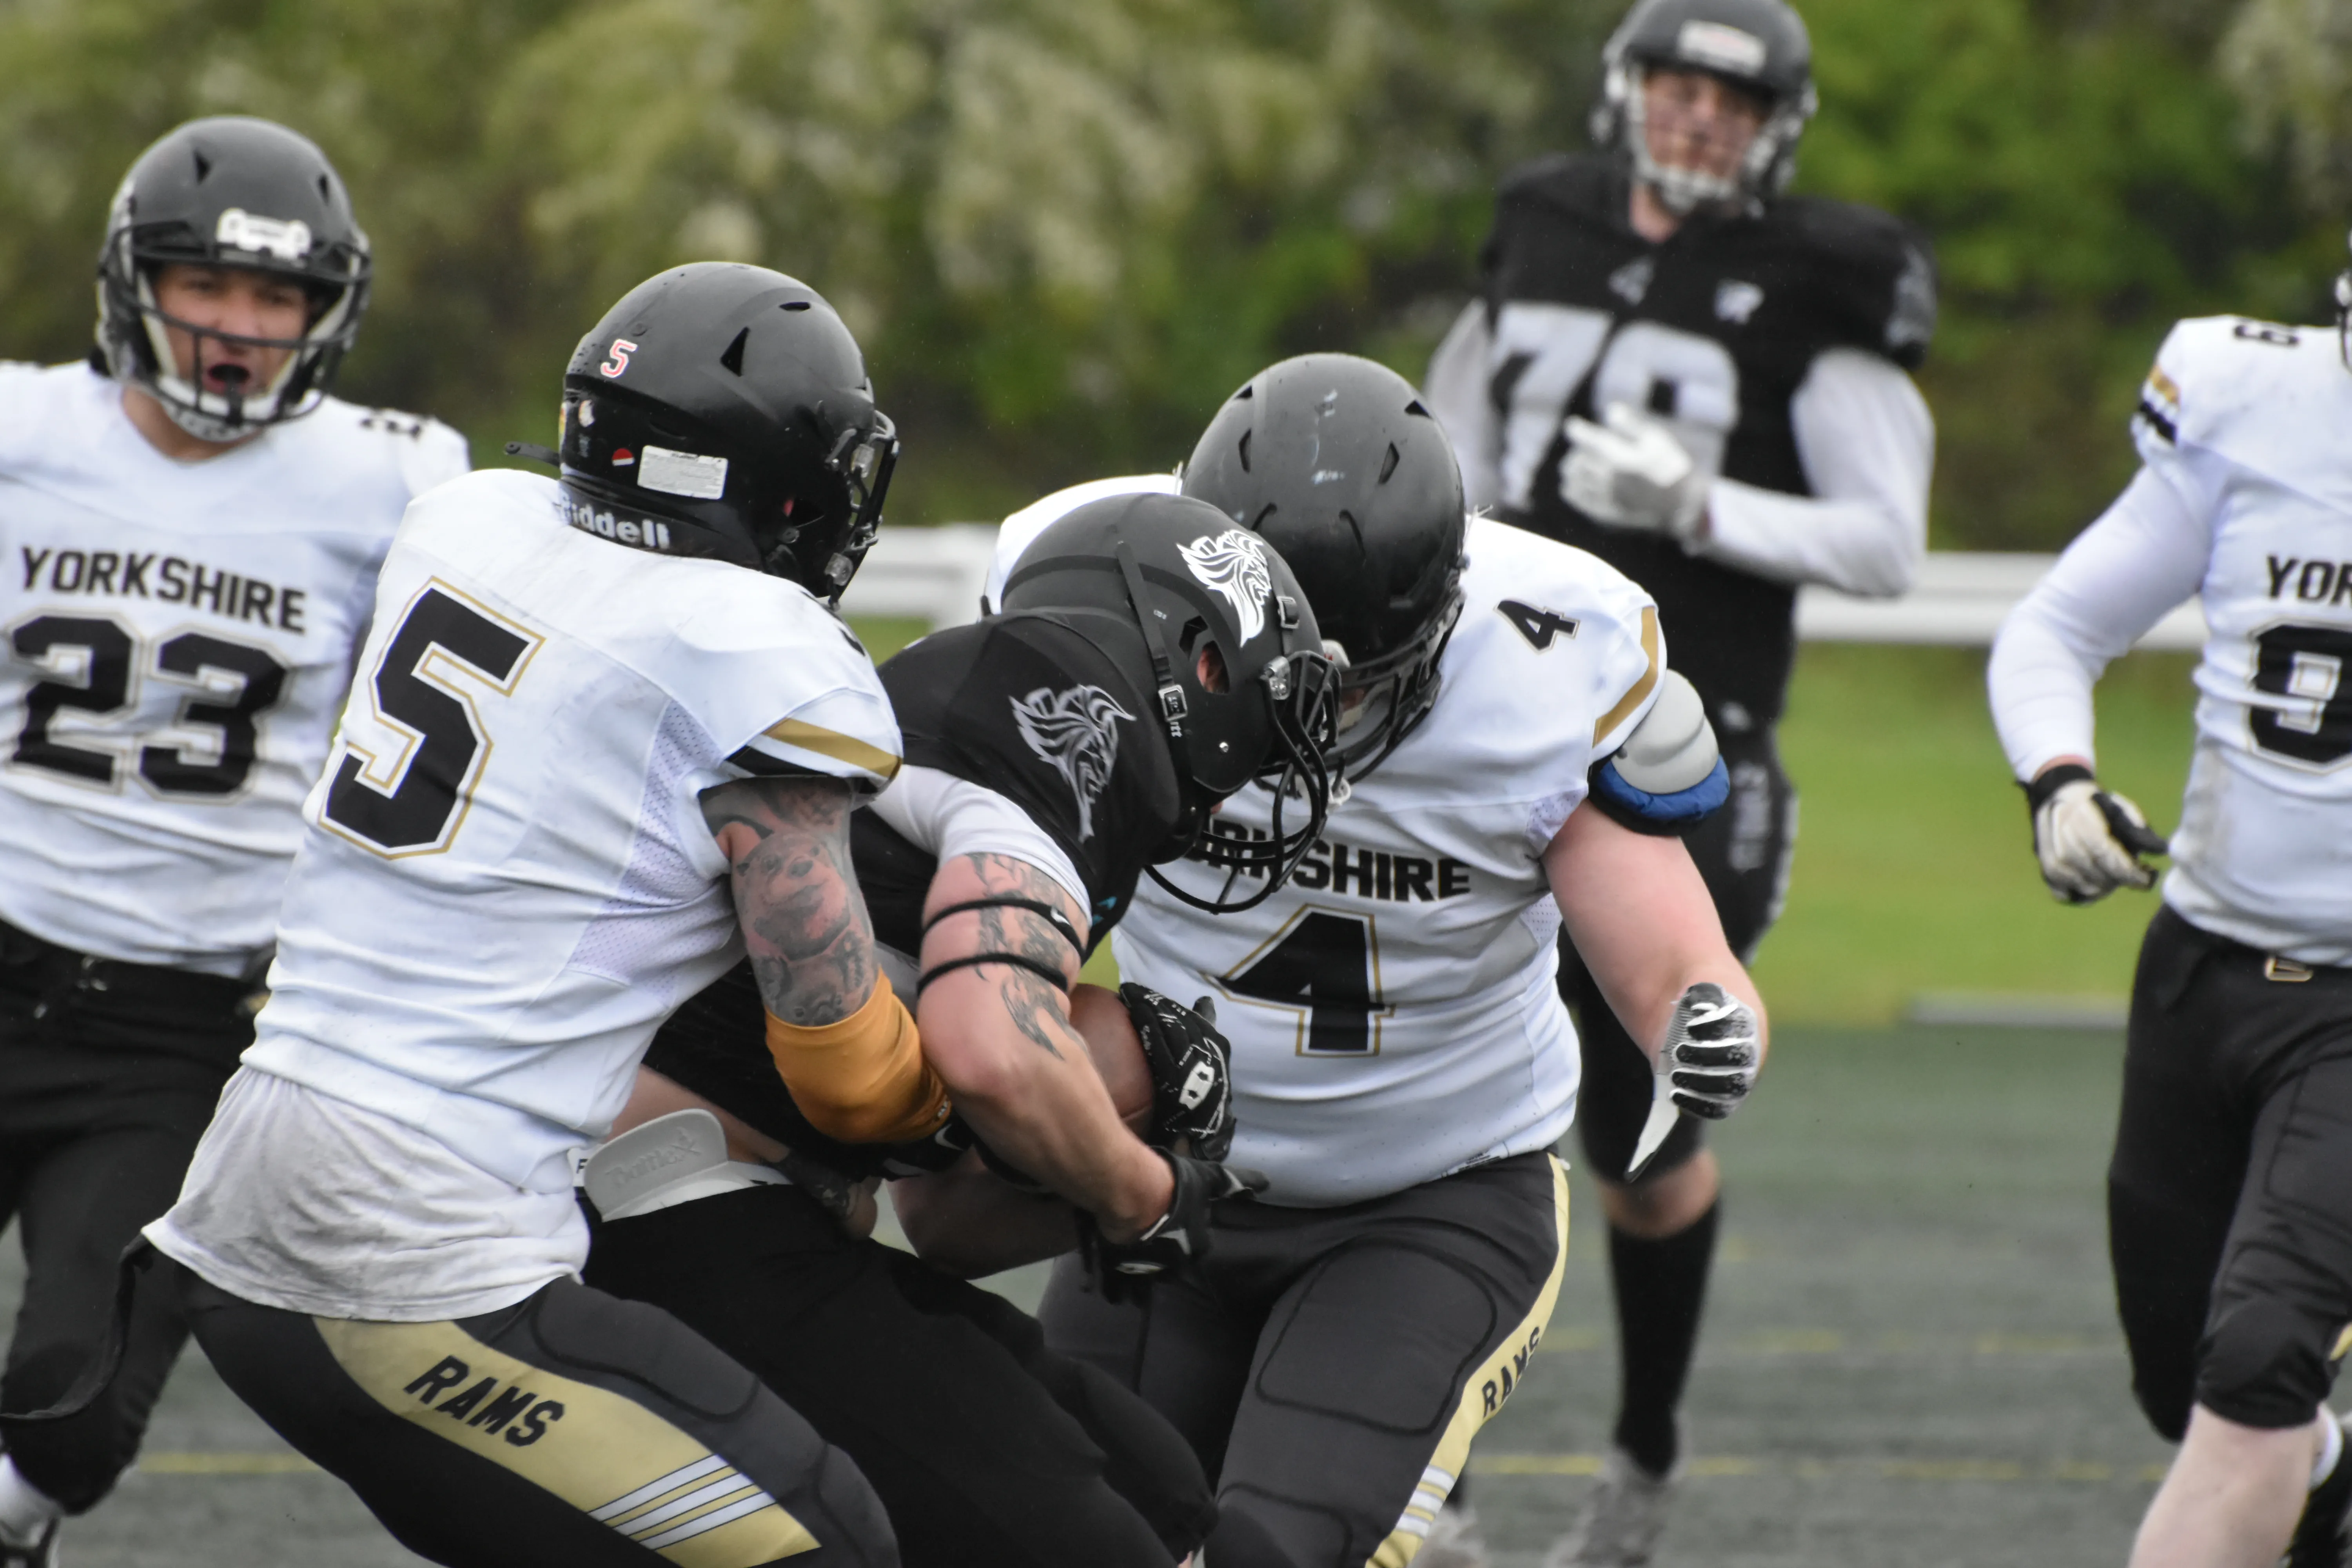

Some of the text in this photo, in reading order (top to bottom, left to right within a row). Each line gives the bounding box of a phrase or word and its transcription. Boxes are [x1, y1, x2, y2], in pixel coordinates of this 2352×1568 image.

[600, 339, 637, 378] 5
[22, 546, 307, 633] YORKSHIRE
[1493, 597, 1580, 655] 4
[7, 607, 292, 804] 23
[317, 575, 547, 860] 5
[1181, 818, 1472, 902] RSHIRE
[1200, 903, 1396, 1058] 4
[403, 1355, 565, 1447] RAMS
